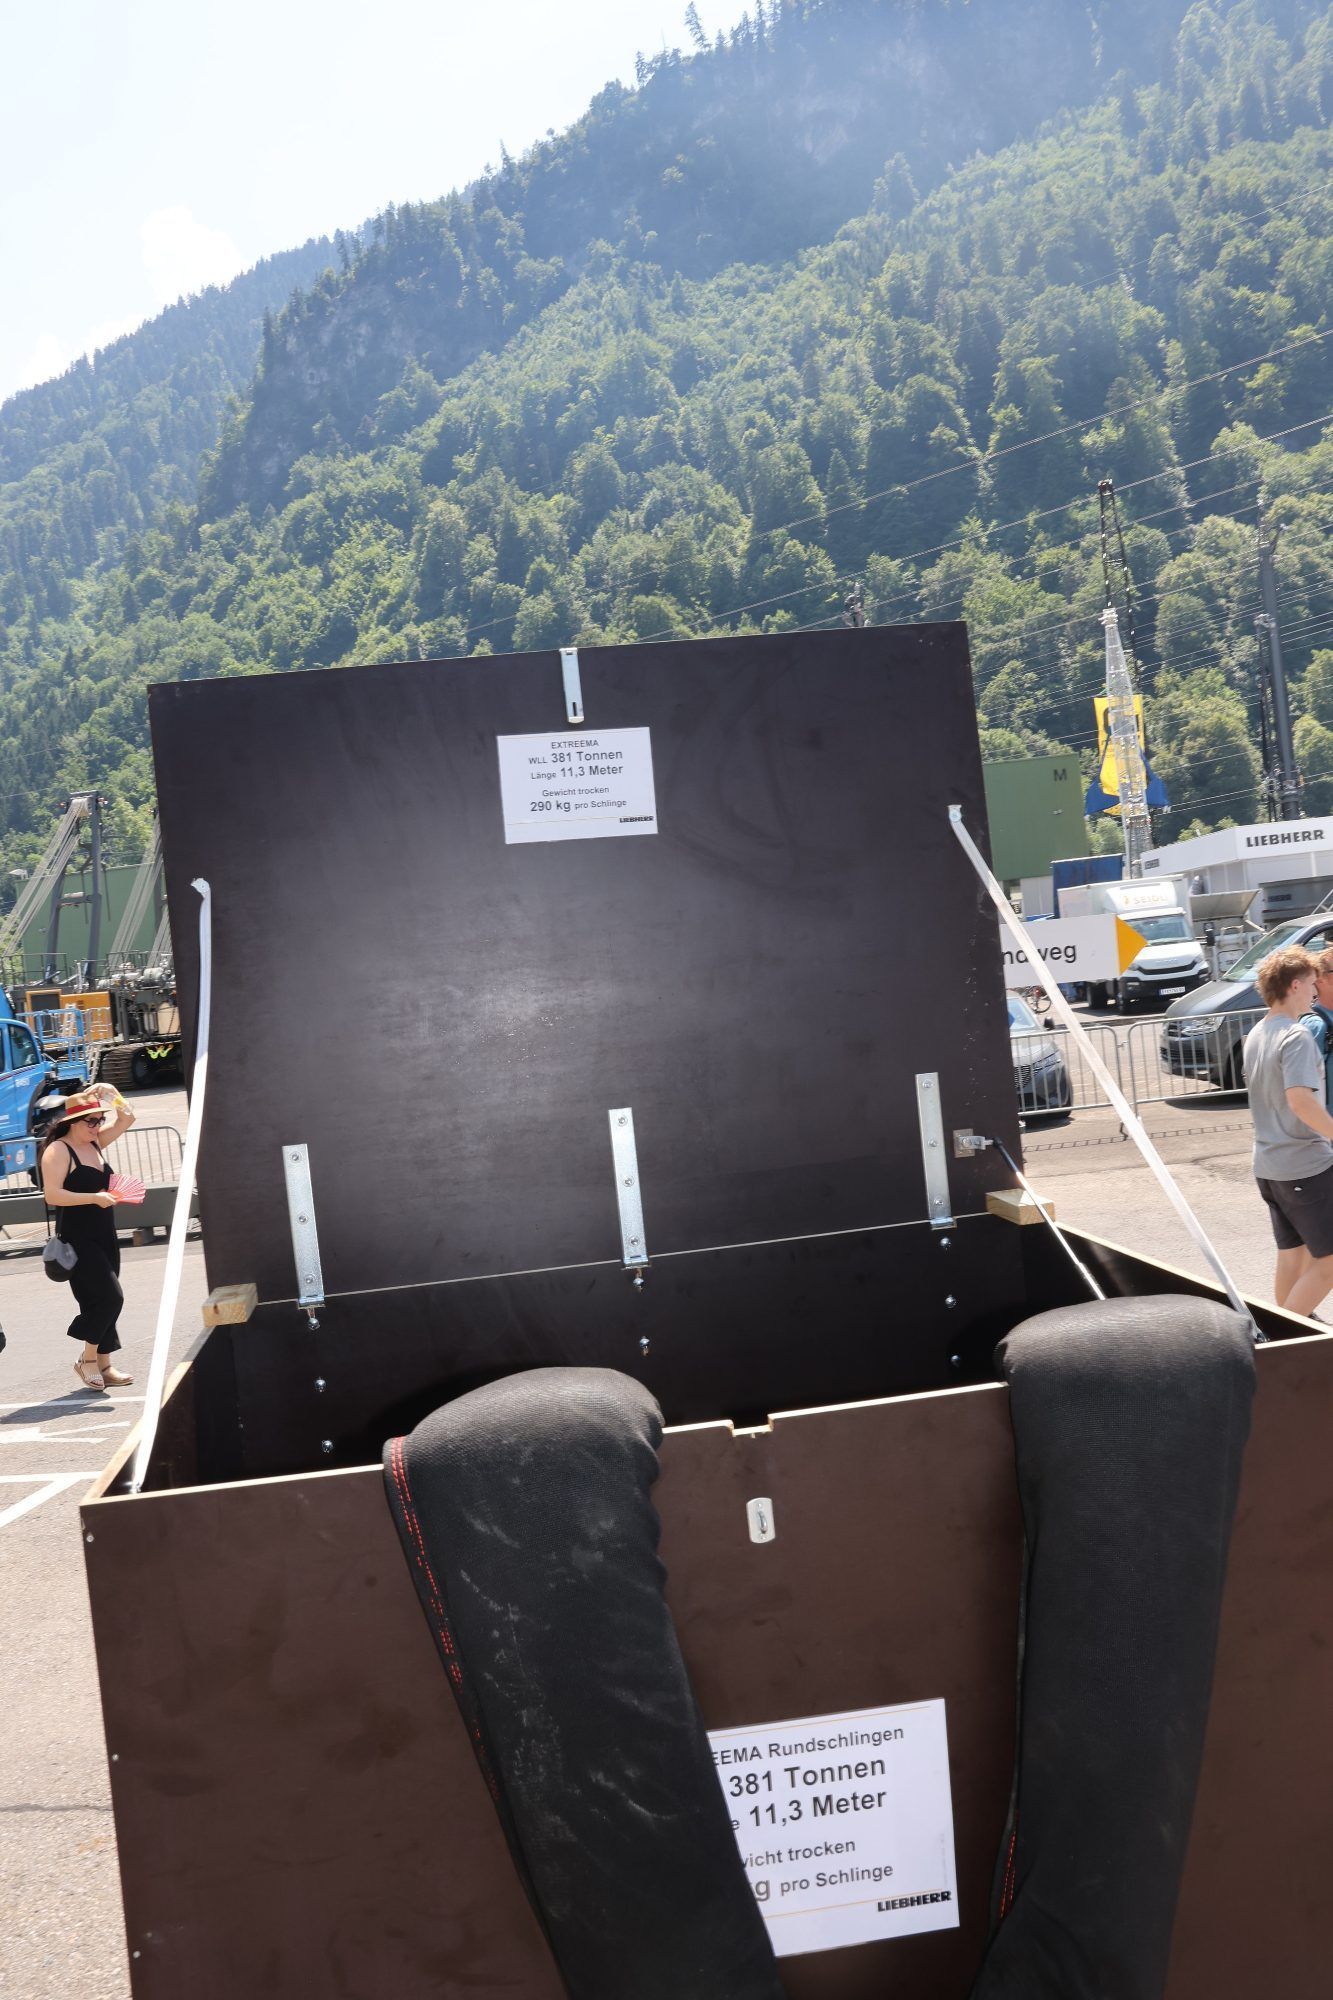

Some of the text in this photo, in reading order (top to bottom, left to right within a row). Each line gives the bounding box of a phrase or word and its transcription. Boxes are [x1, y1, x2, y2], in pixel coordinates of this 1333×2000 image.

[551, 739, 600, 749] EXTREEMA
[528, 750, 623, 765] WLL 381 Tonnen
[531, 765, 623, 780] Länge 11,3 Meter
[1053, 768, 1068, 782] M
[542, 786, 610, 797] Gewicht trocken
[530, 799, 627, 813] 290 kg pro Schlinge
[1246, 829, 1325, 847] LIEBHERR
[768, 1727, 905, 1758] Rundschlingen
[729, 1758, 886, 1798] 381 Tonnen
[749, 1799, 803, 1827] 11,3
[812, 1790, 887, 1818] Meter
[788, 1839, 856, 1862] trocken
[751, 1863, 894, 1902] g pro Schlinge
[877, 1890, 952, 1913] LIEBHERR
